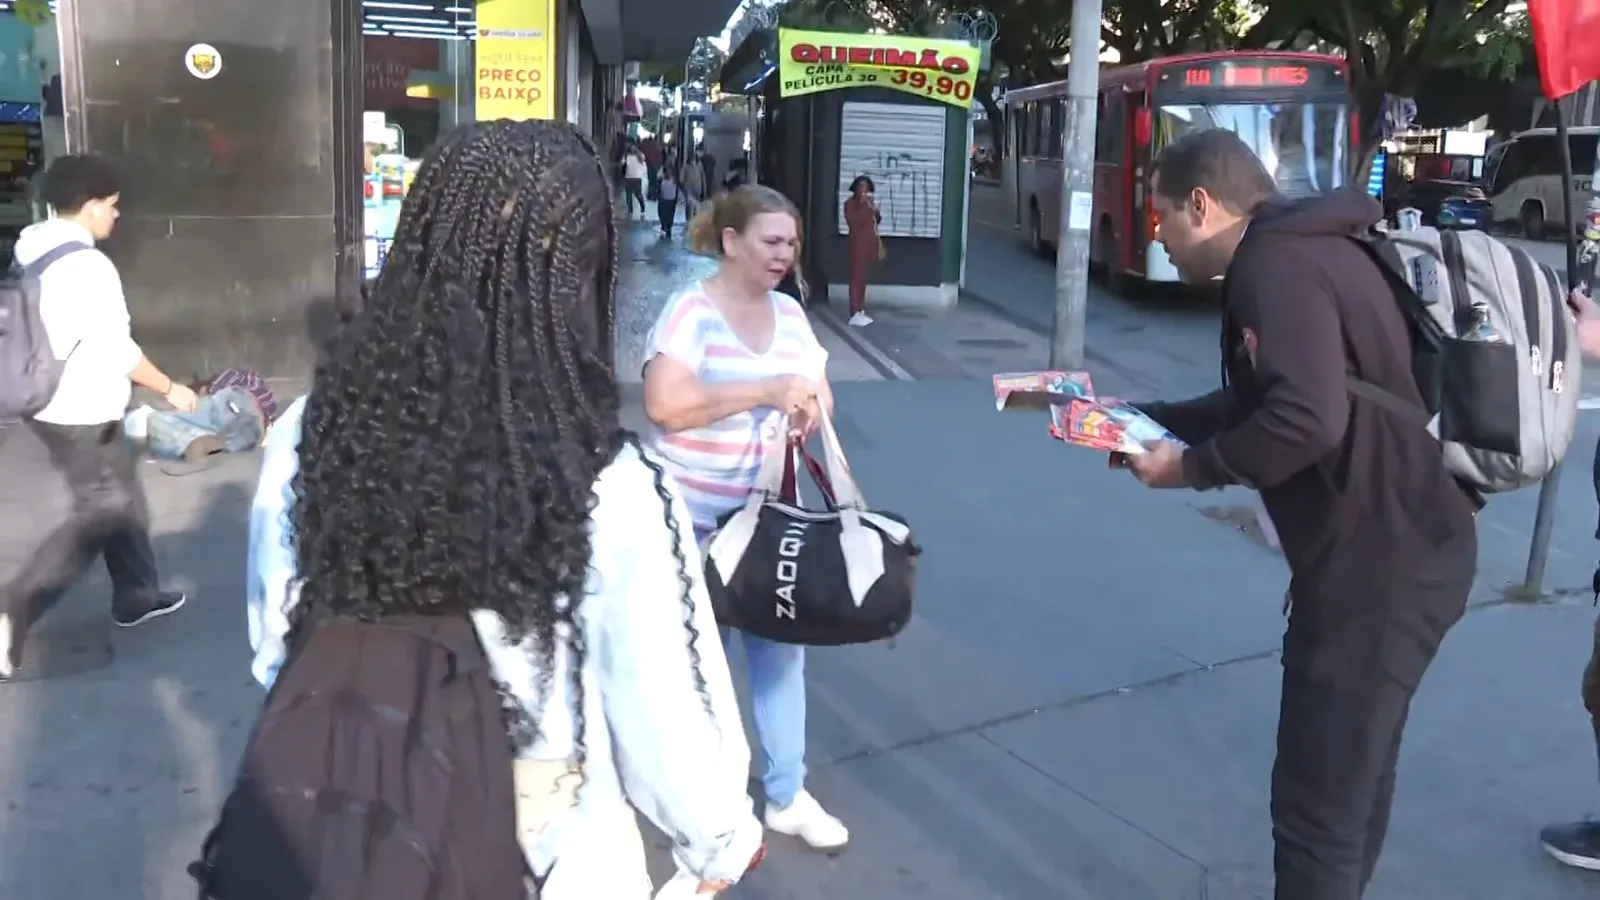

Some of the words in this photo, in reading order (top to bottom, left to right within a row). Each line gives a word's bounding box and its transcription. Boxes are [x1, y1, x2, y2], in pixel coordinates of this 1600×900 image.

[791, 43, 969, 75] QUEIMÃO
[479, 68, 541, 83] PREÇO
[805, 64, 844, 75] CAPA
[785, 74, 854, 90] PELÍCULA
[890, 69, 971, 100] 39,90
[479, 86, 541, 102] BAIXO
